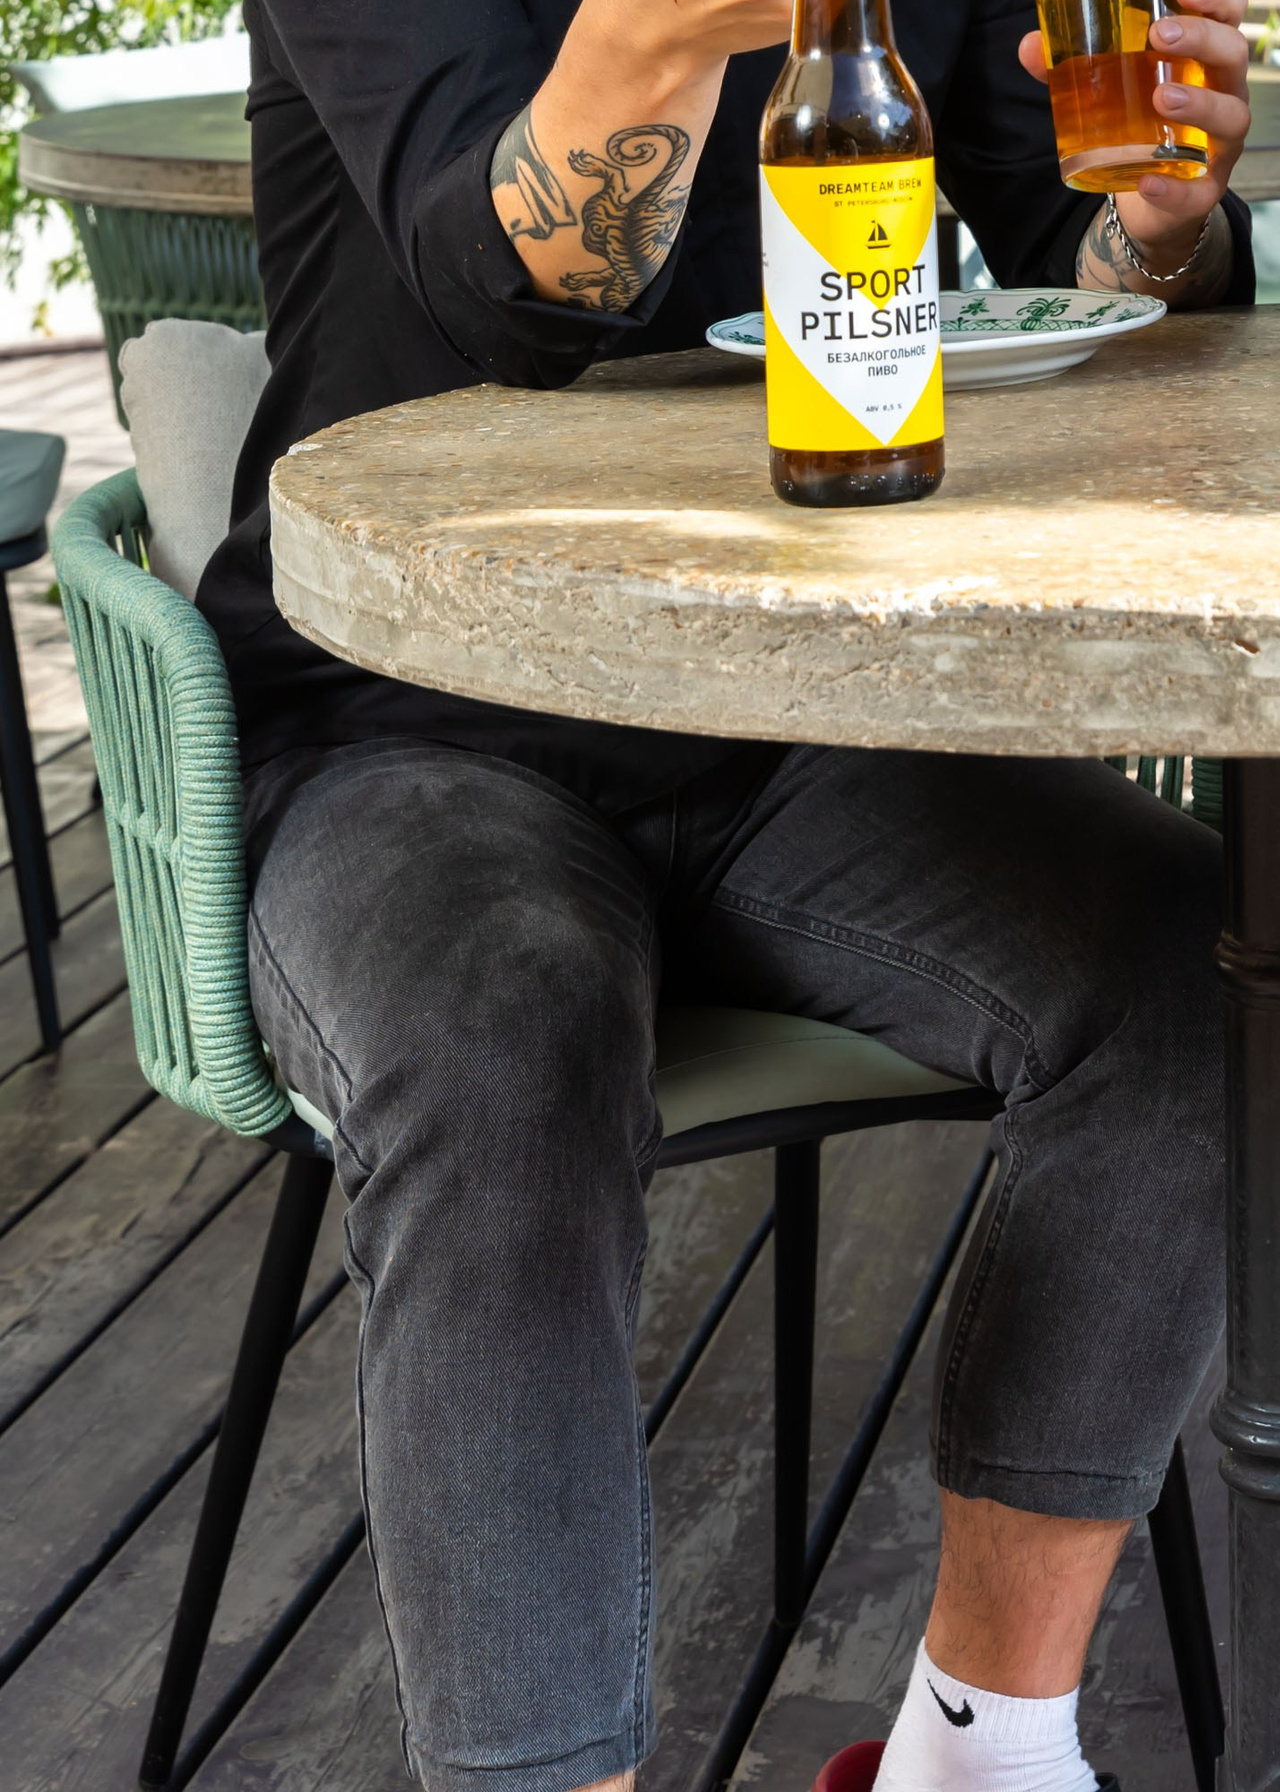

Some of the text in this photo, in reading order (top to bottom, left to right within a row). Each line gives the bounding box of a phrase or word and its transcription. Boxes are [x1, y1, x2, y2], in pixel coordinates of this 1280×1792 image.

[819, 178, 922, 195] DREAMTEAM BREW
[820, 264, 926, 301] SPORT
[801, 301, 938, 341] PILSNER
[827, 345, 926, 363] БЕЗАЛКОГОЛЬНОЕ
[868, 365, 898, 377] ПИВО
